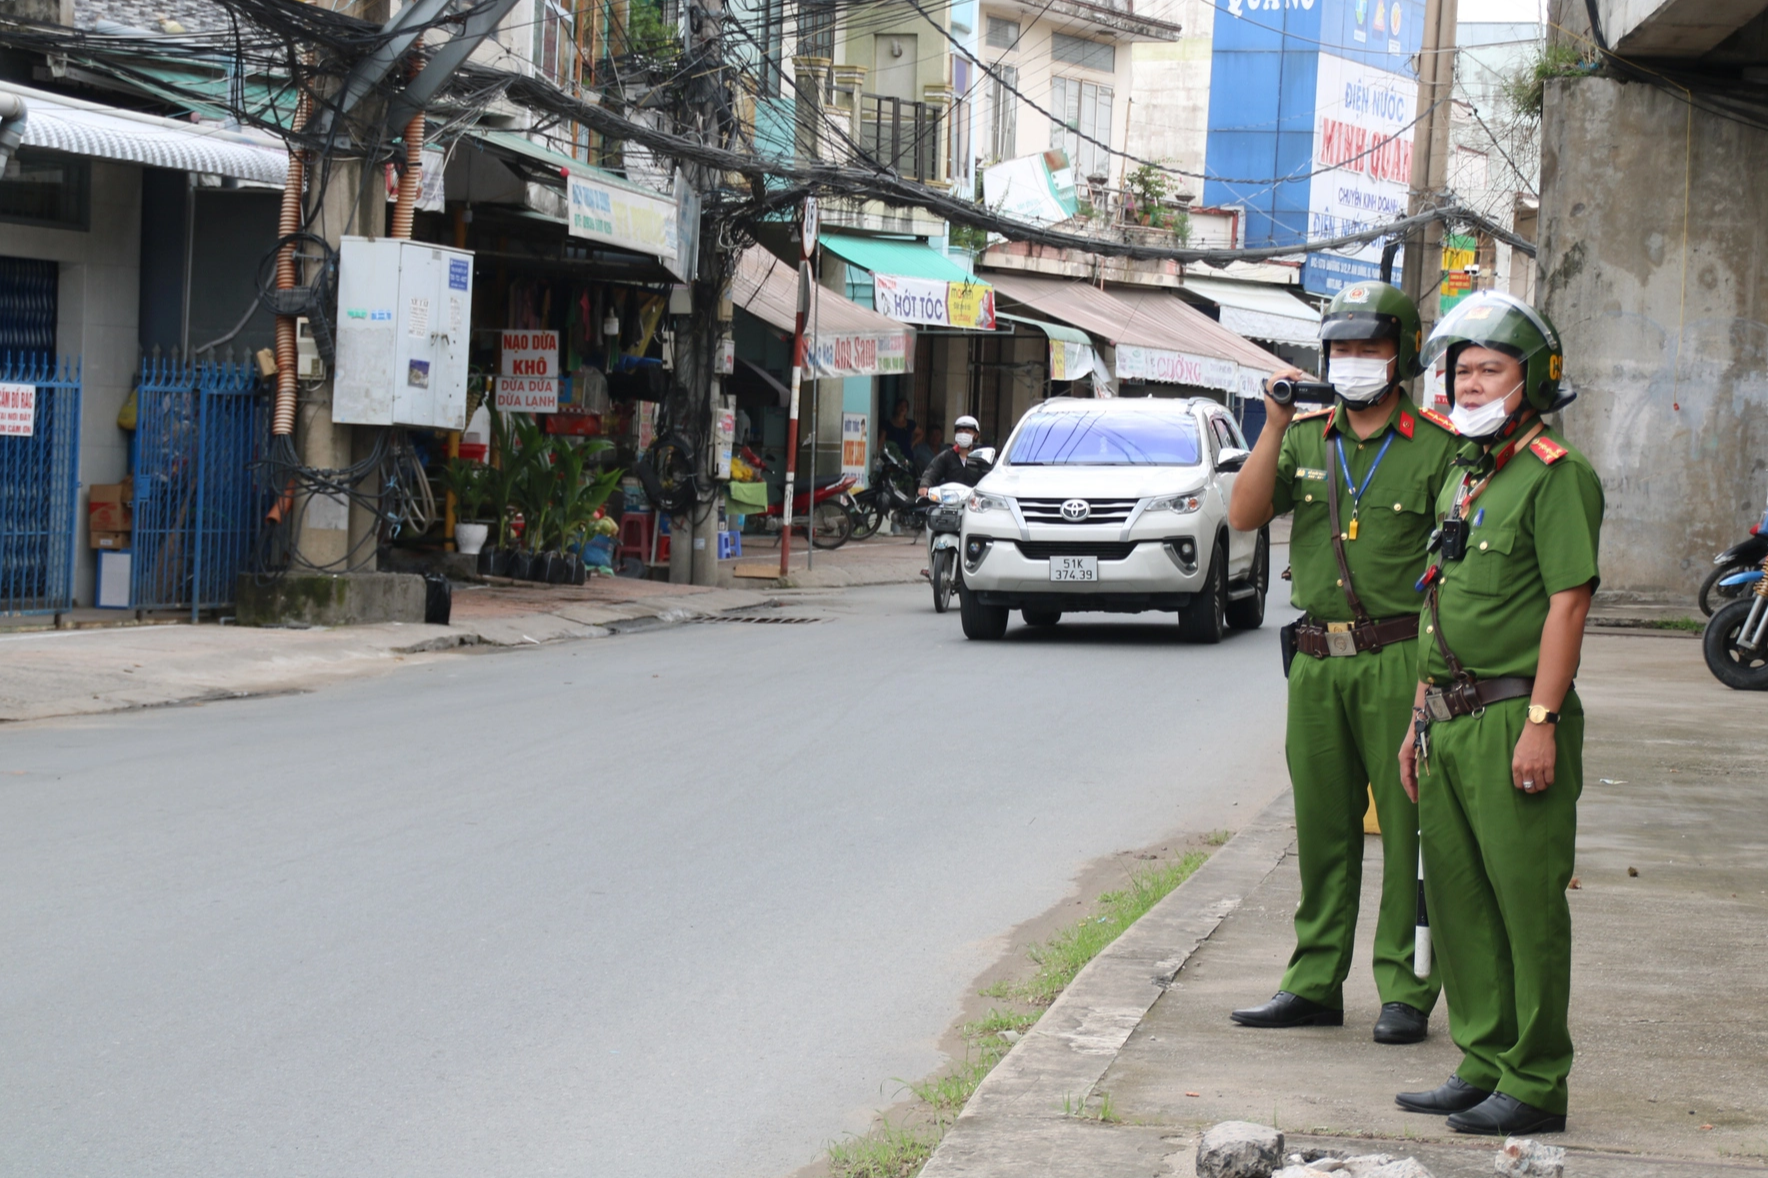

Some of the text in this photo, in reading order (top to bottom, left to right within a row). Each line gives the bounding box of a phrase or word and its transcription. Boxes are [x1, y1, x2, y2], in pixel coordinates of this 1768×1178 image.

[1345, 79, 1404, 123] ĐIỆN NƯỚC
[1321, 117, 1367, 173] MINH
[1339, 187, 1362, 208] CHUYÊN
[1363, 194, 1377, 210] KINH
[894, 288, 943, 320] HỚT TÓC
[503, 331, 557, 353] NẠO DỪA
[513, 356, 547, 375] KHÔ
[501, 377, 525, 392] DỪA
[525, 395, 556, 410] LẠNH
[1063, 558, 1083, 569] 51K
[1055, 569, 1093, 580] 374.39
